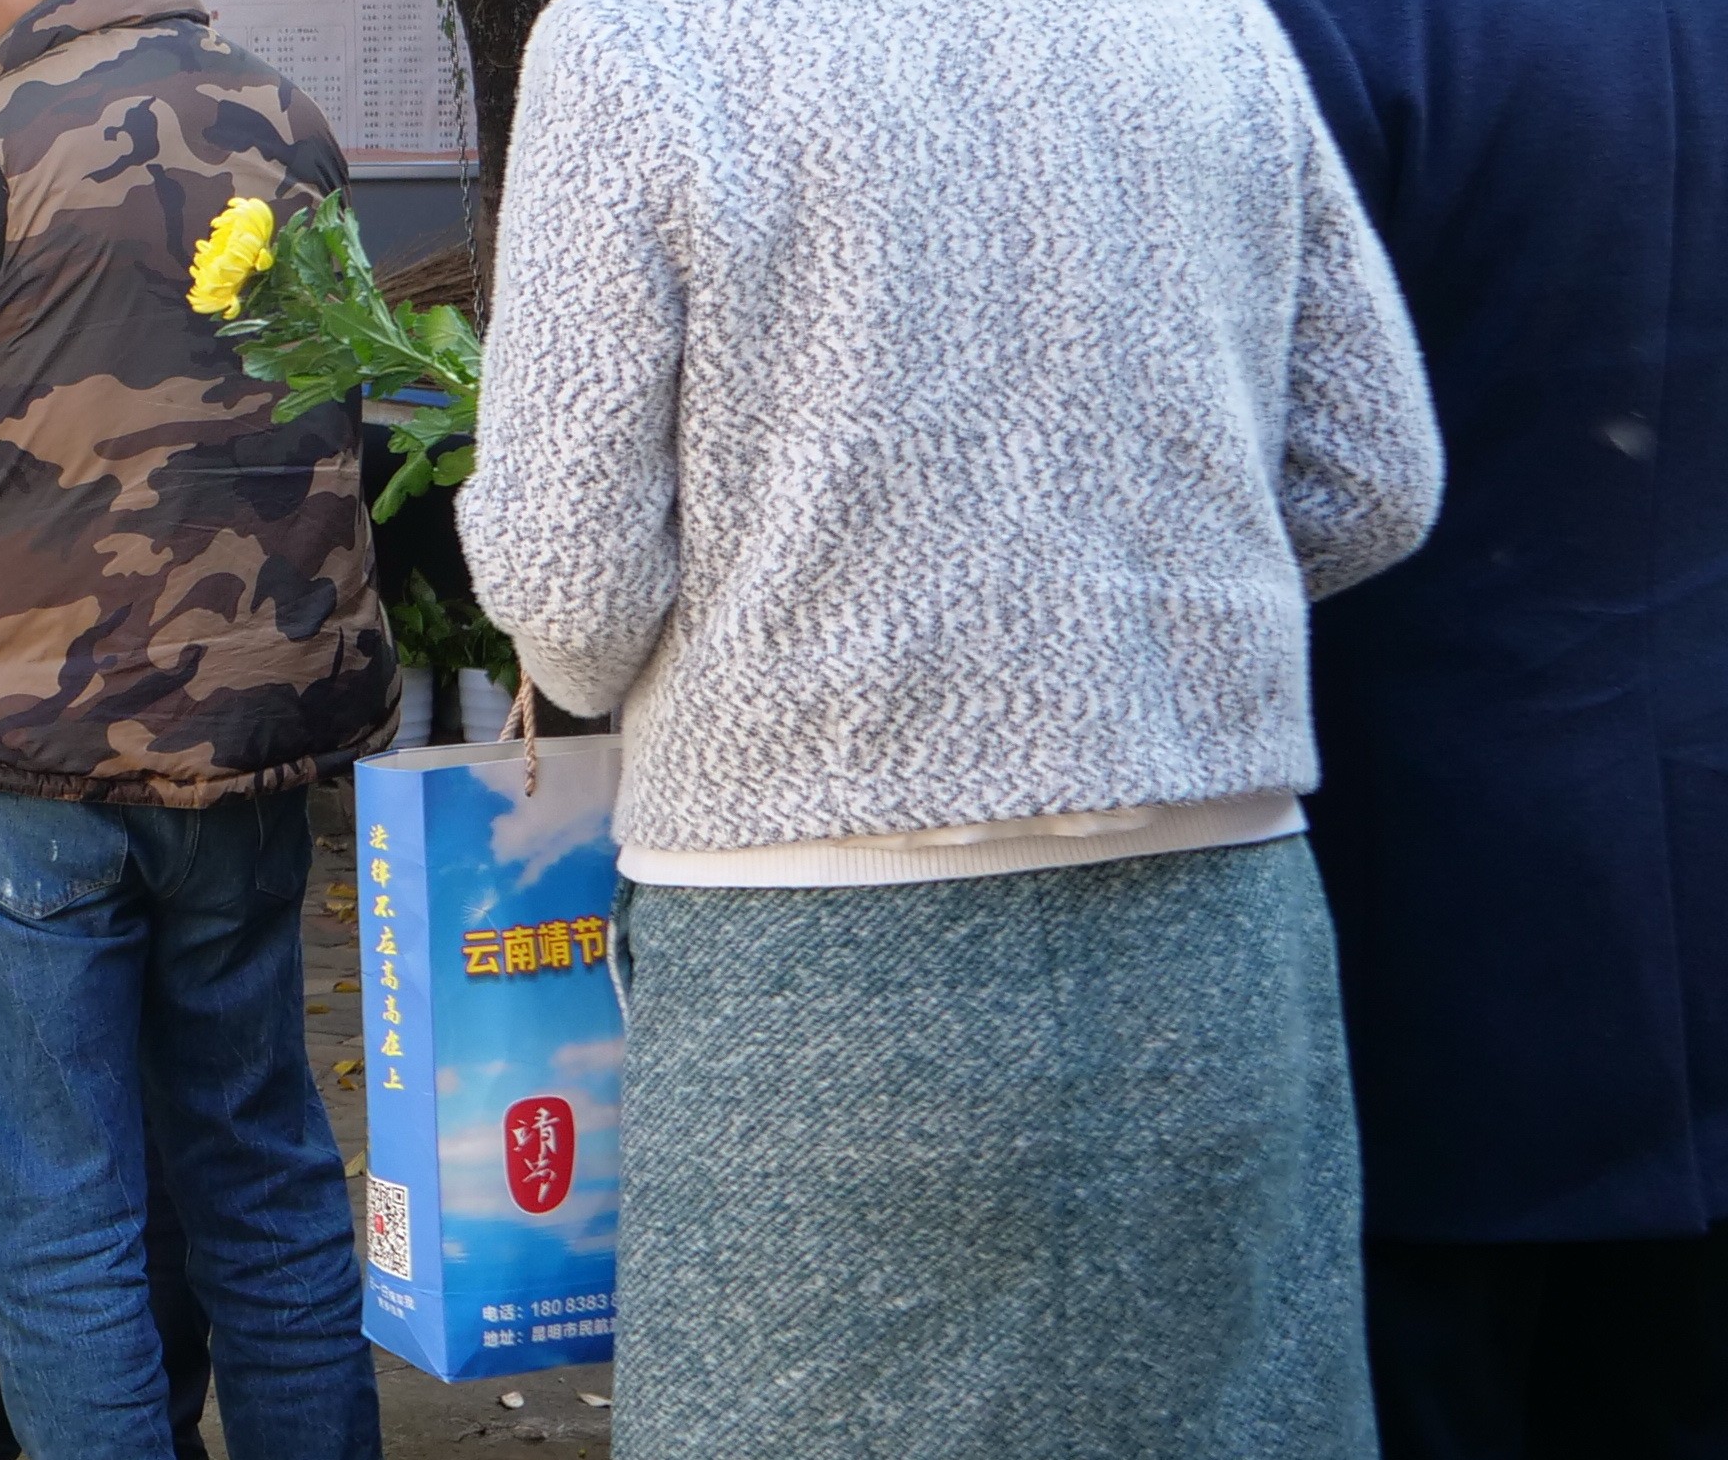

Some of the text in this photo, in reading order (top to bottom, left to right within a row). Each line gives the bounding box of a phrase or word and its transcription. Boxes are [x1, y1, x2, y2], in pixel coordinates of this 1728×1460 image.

[368, 823, 405, 1091] 法律不应高高在上
